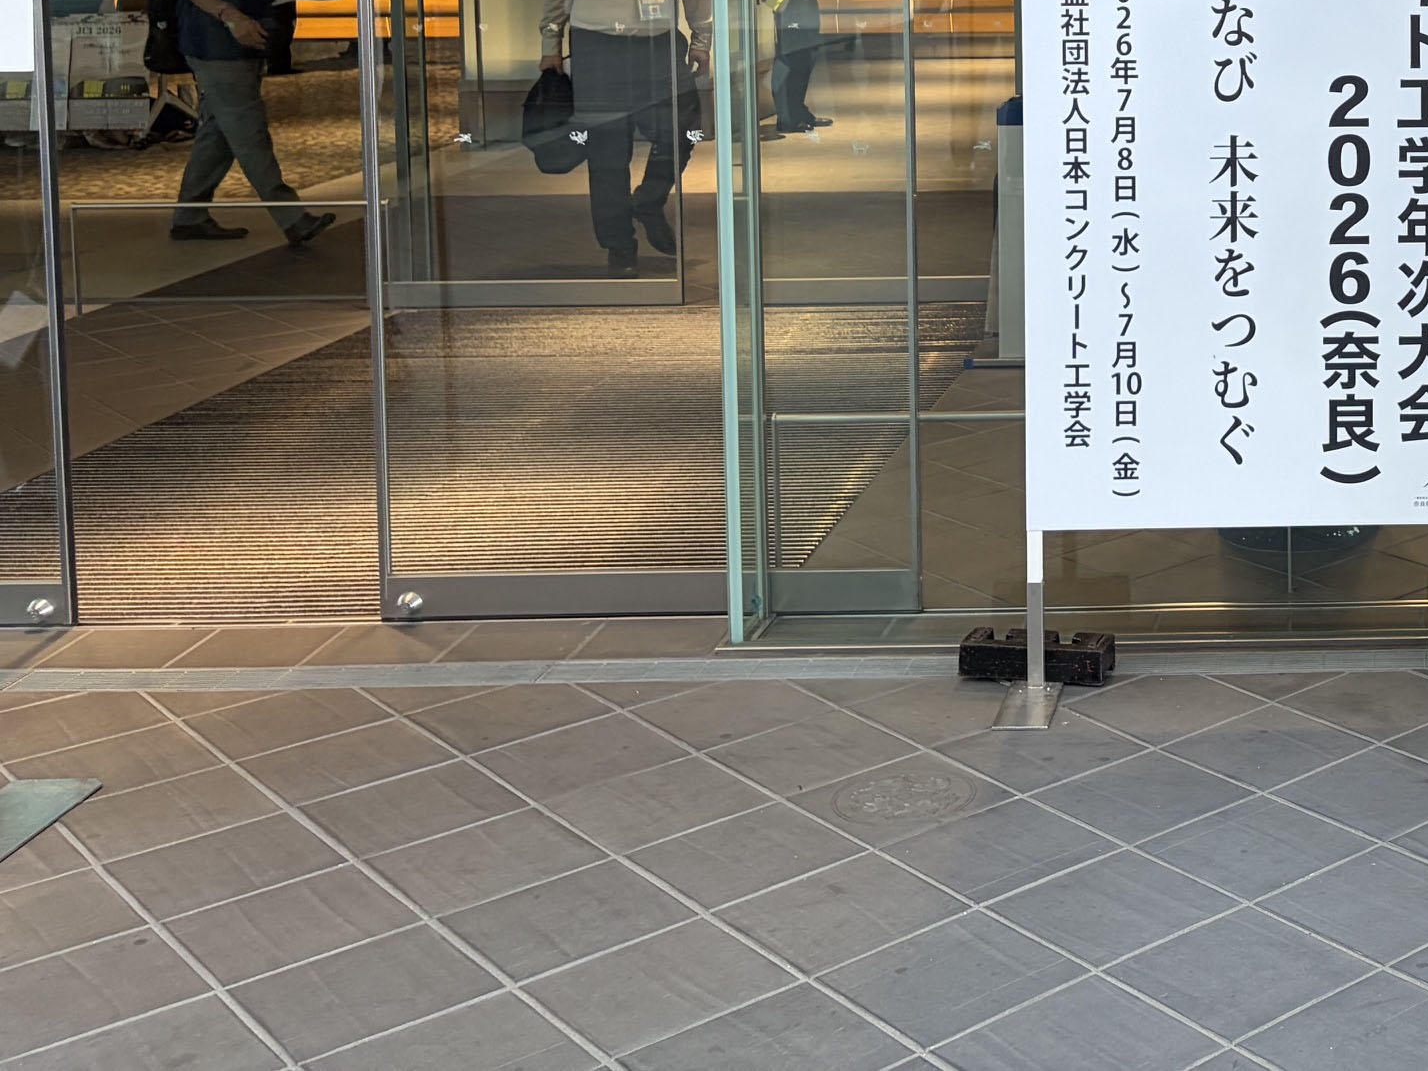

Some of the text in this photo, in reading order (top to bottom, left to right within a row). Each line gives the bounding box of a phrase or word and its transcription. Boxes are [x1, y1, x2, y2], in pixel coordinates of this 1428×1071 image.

[1209, 134, 1259, 465] 未来をつむぐ
